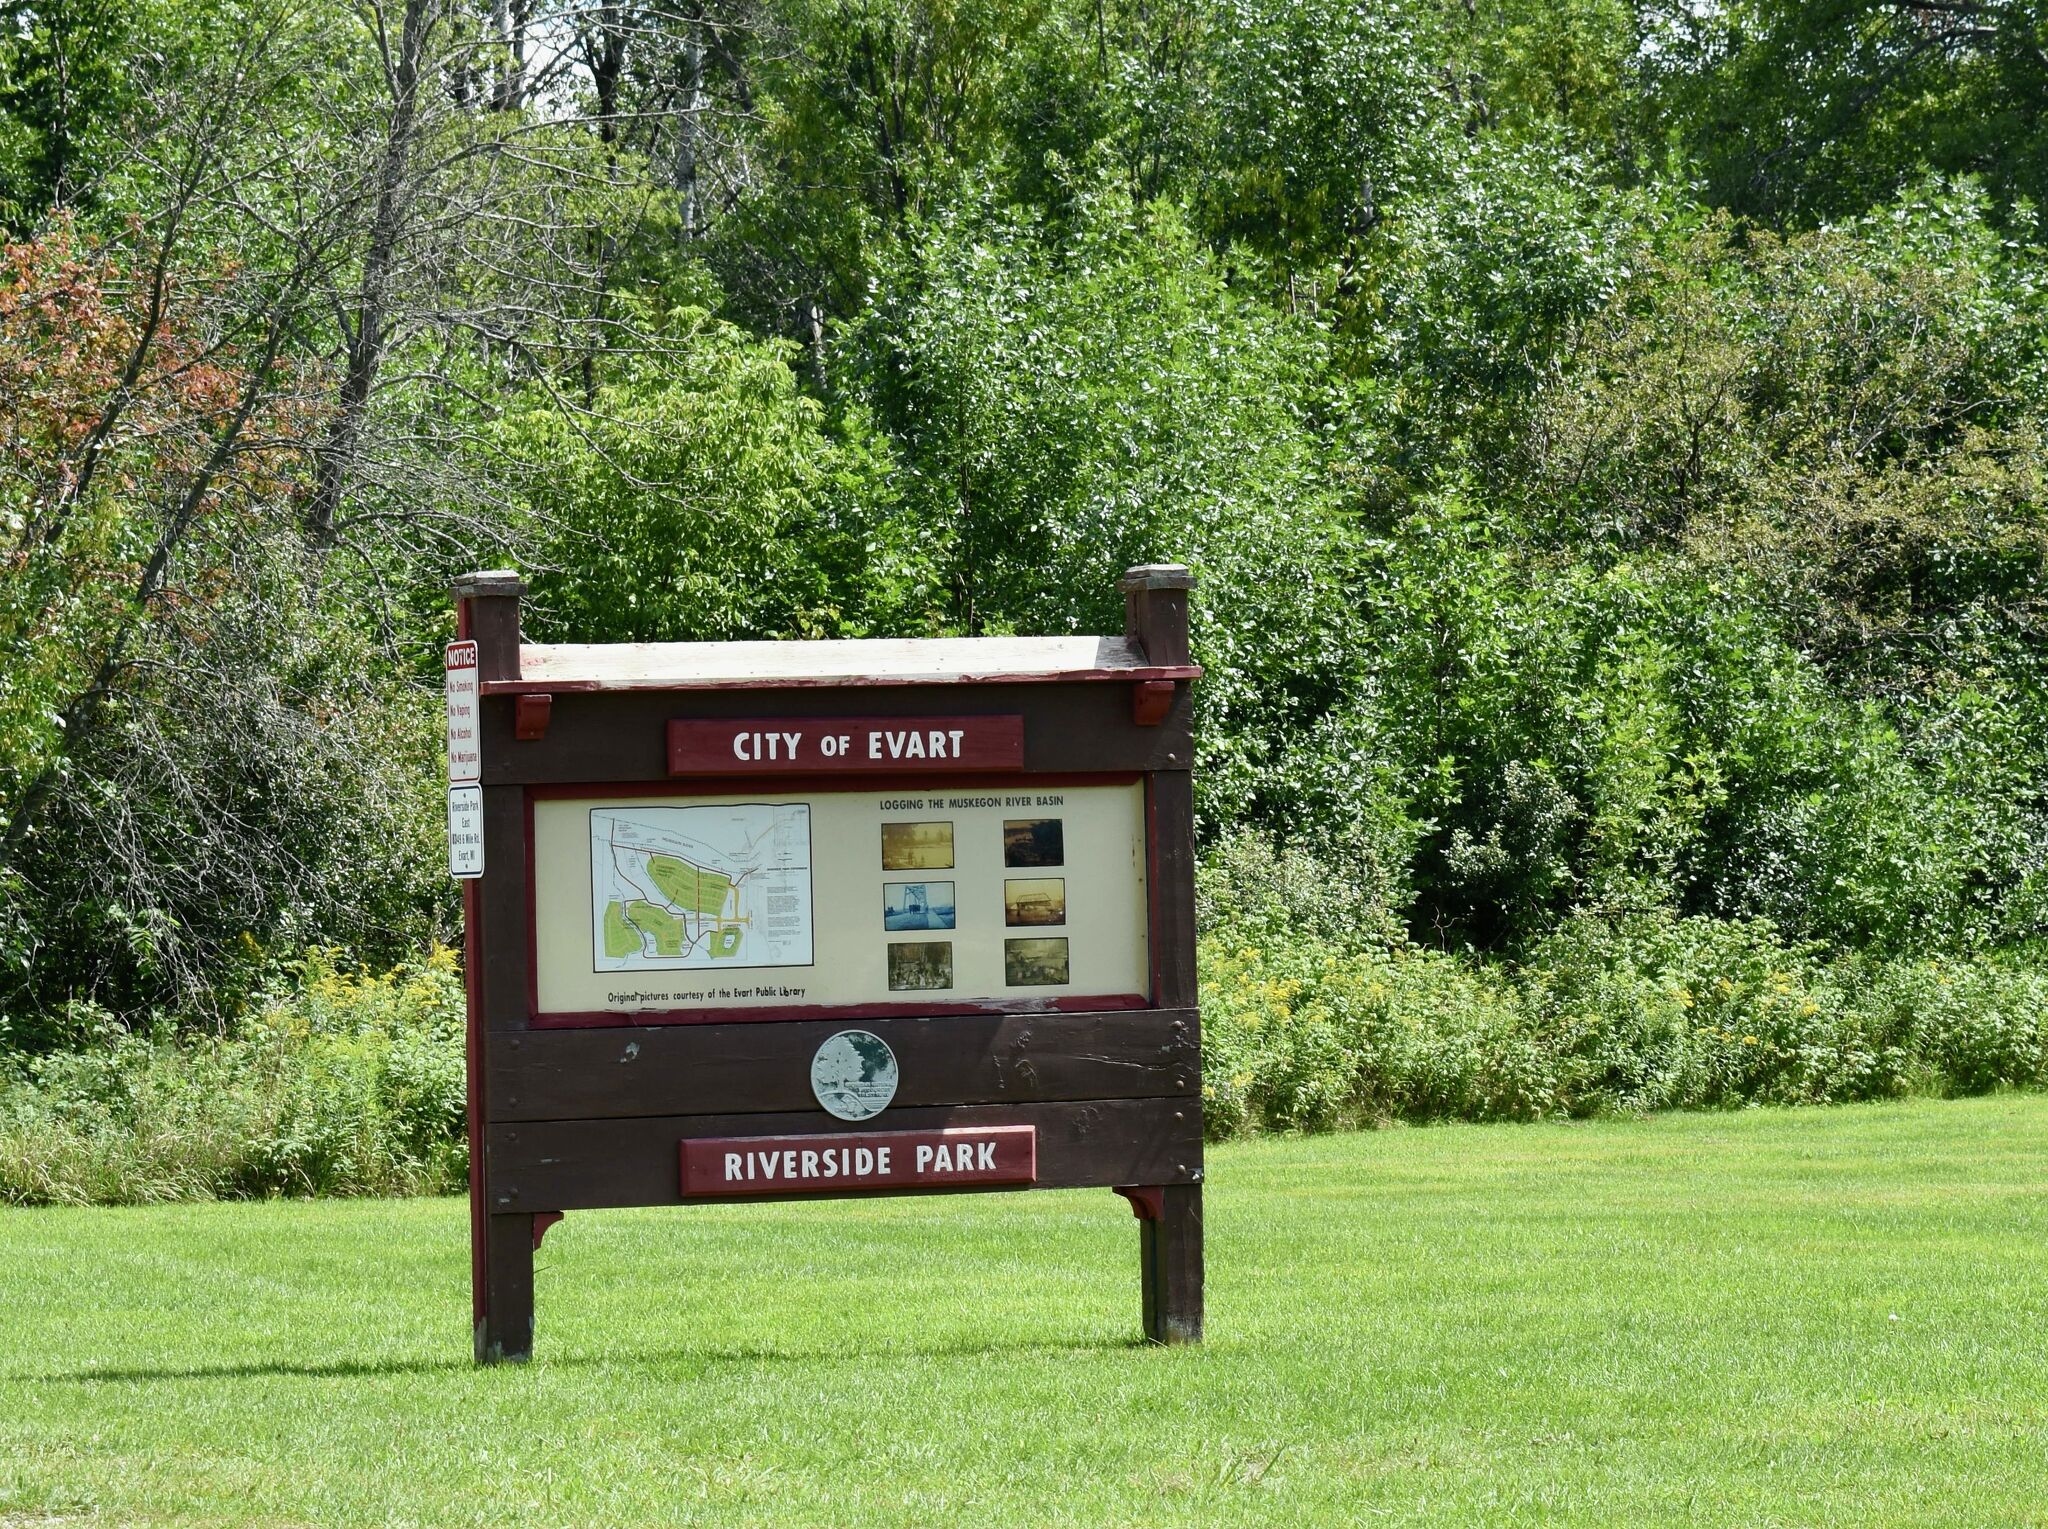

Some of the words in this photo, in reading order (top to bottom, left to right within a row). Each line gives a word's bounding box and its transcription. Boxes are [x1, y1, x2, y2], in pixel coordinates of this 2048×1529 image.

[448, 647, 475, 667] NOTICE
[450, 683, 456, 693] No
[456, 680, 474, 694] Smoking
[450, 704, 456, 717] No
[457, 703, 471, 718] Vaping
[450, 728, 457, 740] No
[457, 727, 472, 739] Alcohol
[733, 732, 802, 760] CITY
[820, 736, 850, 756] OF
[869, 731, 964, 759] EVART
[451, 751, 457, 763] No
[458, 750, 477, 765] Marijuana
[452, 801, 470, 812] Riverside
[470, 800, 479, 811] Park
[880, 800, 924, 810] LOGGING
[928, 798, 944, 809] THE
[949, 797, 1001, 808] MUSKEGON
[1005, 796, 1032, 807] RIVER
[1036, 795, 1064, 806] BASIN
[461, 817, 471, 828] East
[608, 991, 638, 1004] Original
[640, 991, 669, 1003] pictures
[673, 990, 704, 1002] courtesy
[708, 989, 716, 999] of
[719, 988, 731, 998] the
[734, 988, 753, 998] Evart
[756, 987, 777, 997] Public
[779, 986, 806, 998] Library
[725, 1147, 891, 1181] RIVERSIDE
[916, 1142, 997, 1173] PARK
